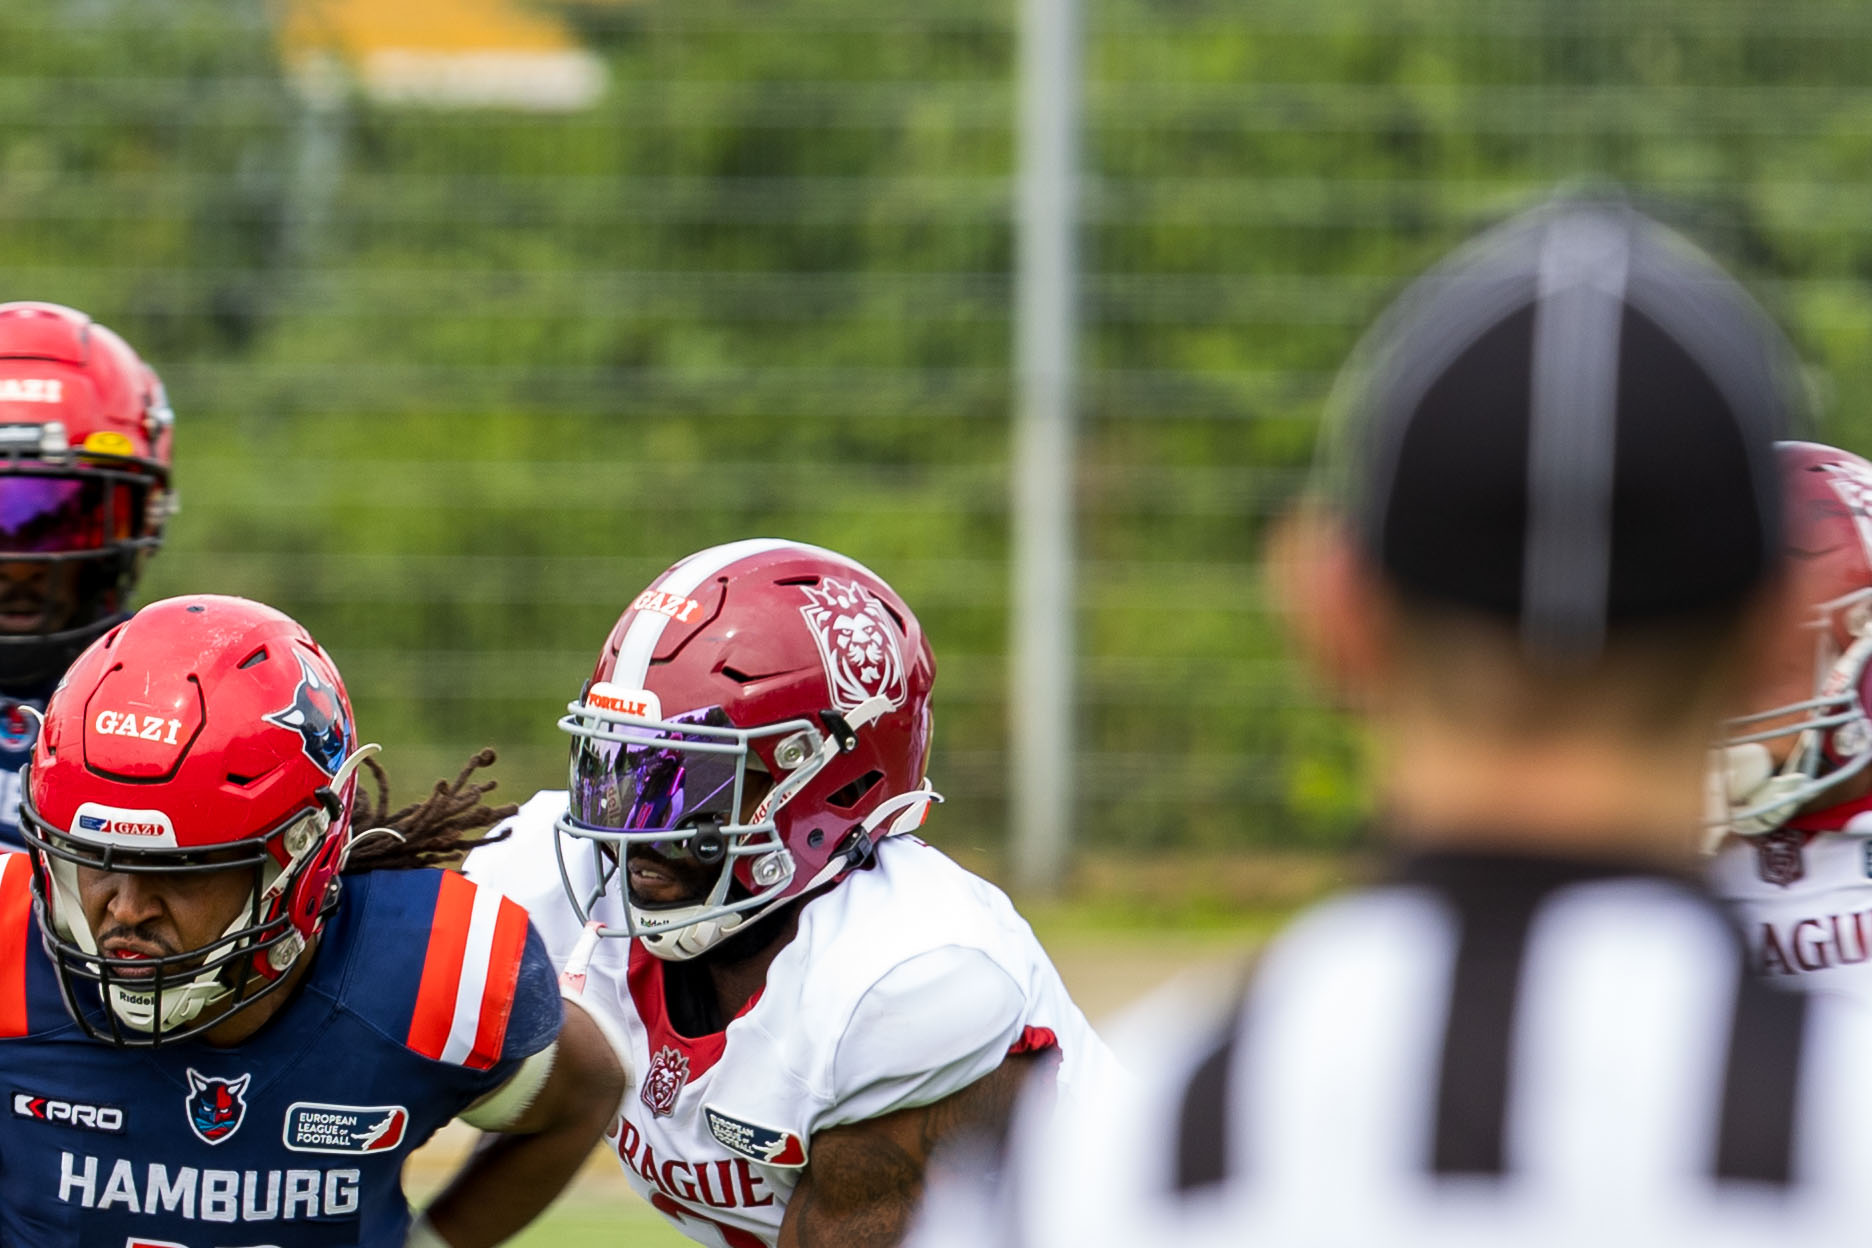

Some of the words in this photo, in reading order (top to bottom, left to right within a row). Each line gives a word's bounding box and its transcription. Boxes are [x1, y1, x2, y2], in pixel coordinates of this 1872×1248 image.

[95, 710, 181, 745] GAZI
[118, 823, 160, 837] GAZI
[1758, 908, 1872, 976] AGU
[119, 991, 156, 1006] Riddel
[299, 1112, 358, 1126] EUROPEAN
[297, 1123, 338, 1135] LEAGUE
[296, 1133, 351, 1146] FOOTBALL
[58, 1151, 361, 1223] HAMBURG
